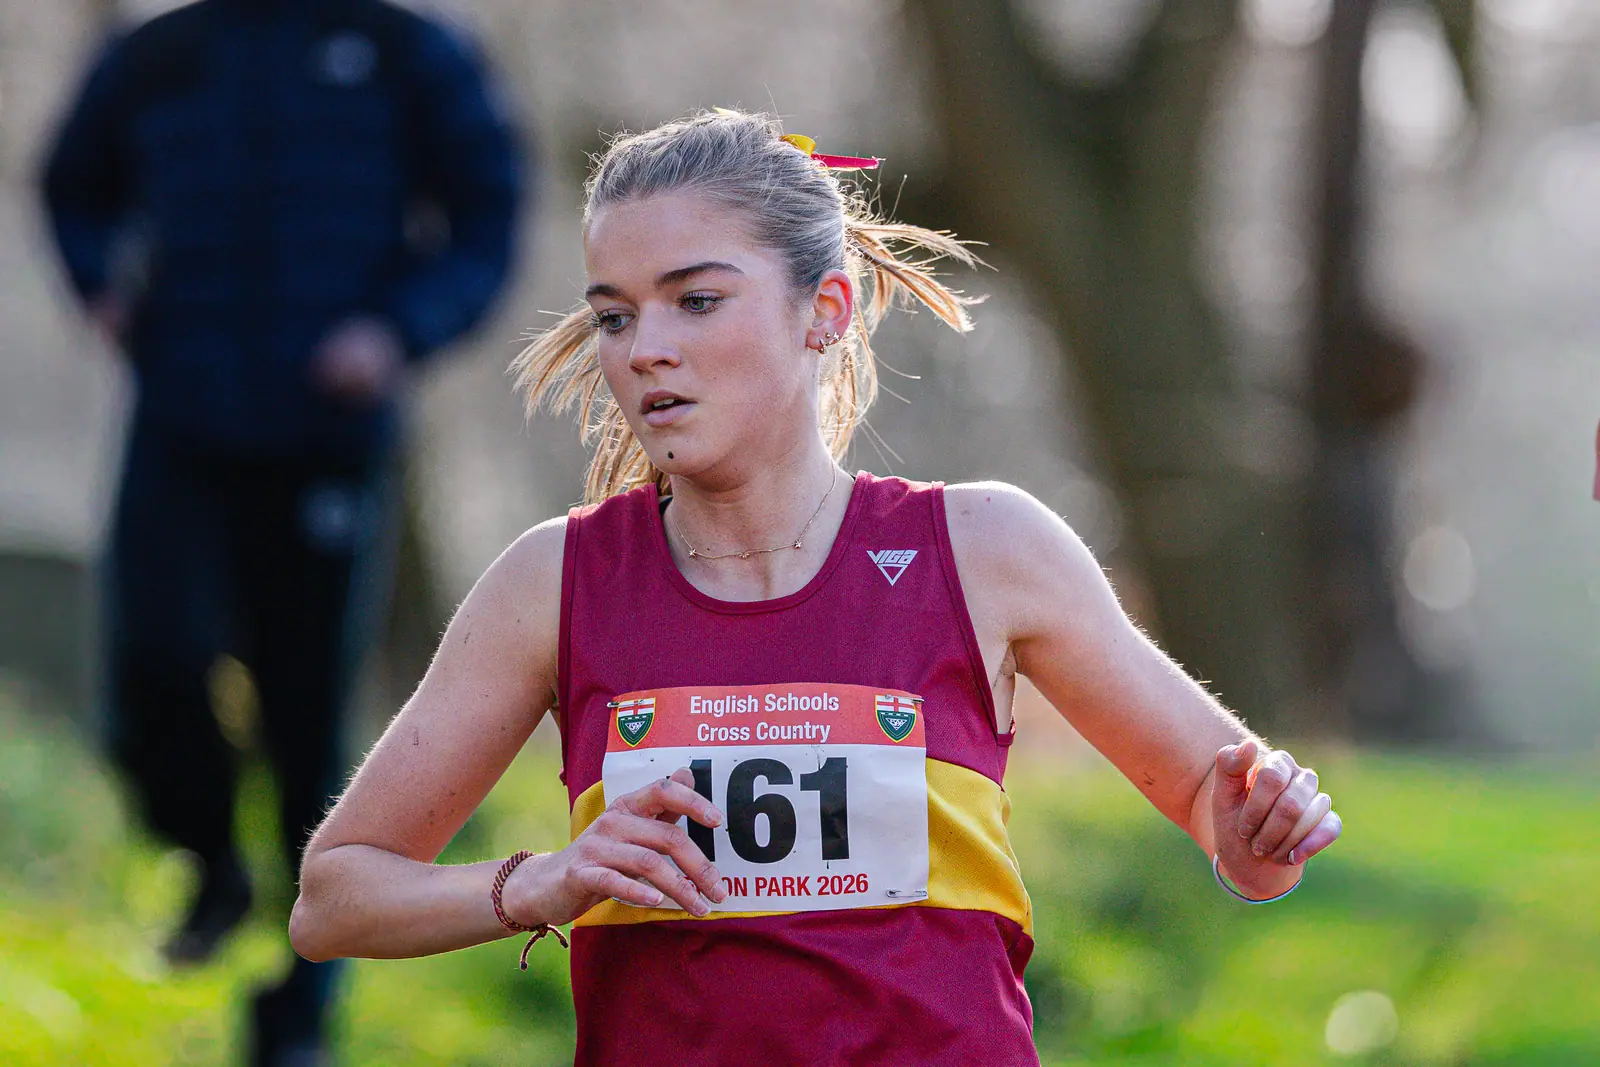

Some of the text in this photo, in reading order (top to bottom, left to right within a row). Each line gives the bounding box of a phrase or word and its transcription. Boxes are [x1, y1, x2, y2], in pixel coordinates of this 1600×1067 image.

[866, 549, 919, 565] VIGA
[689, 693, 840, 718] English Schools
[697, 722, 831, 743] Cross Country
[755, 875, 812, 897] PARK
[816, 873, 869, 896] 2026
